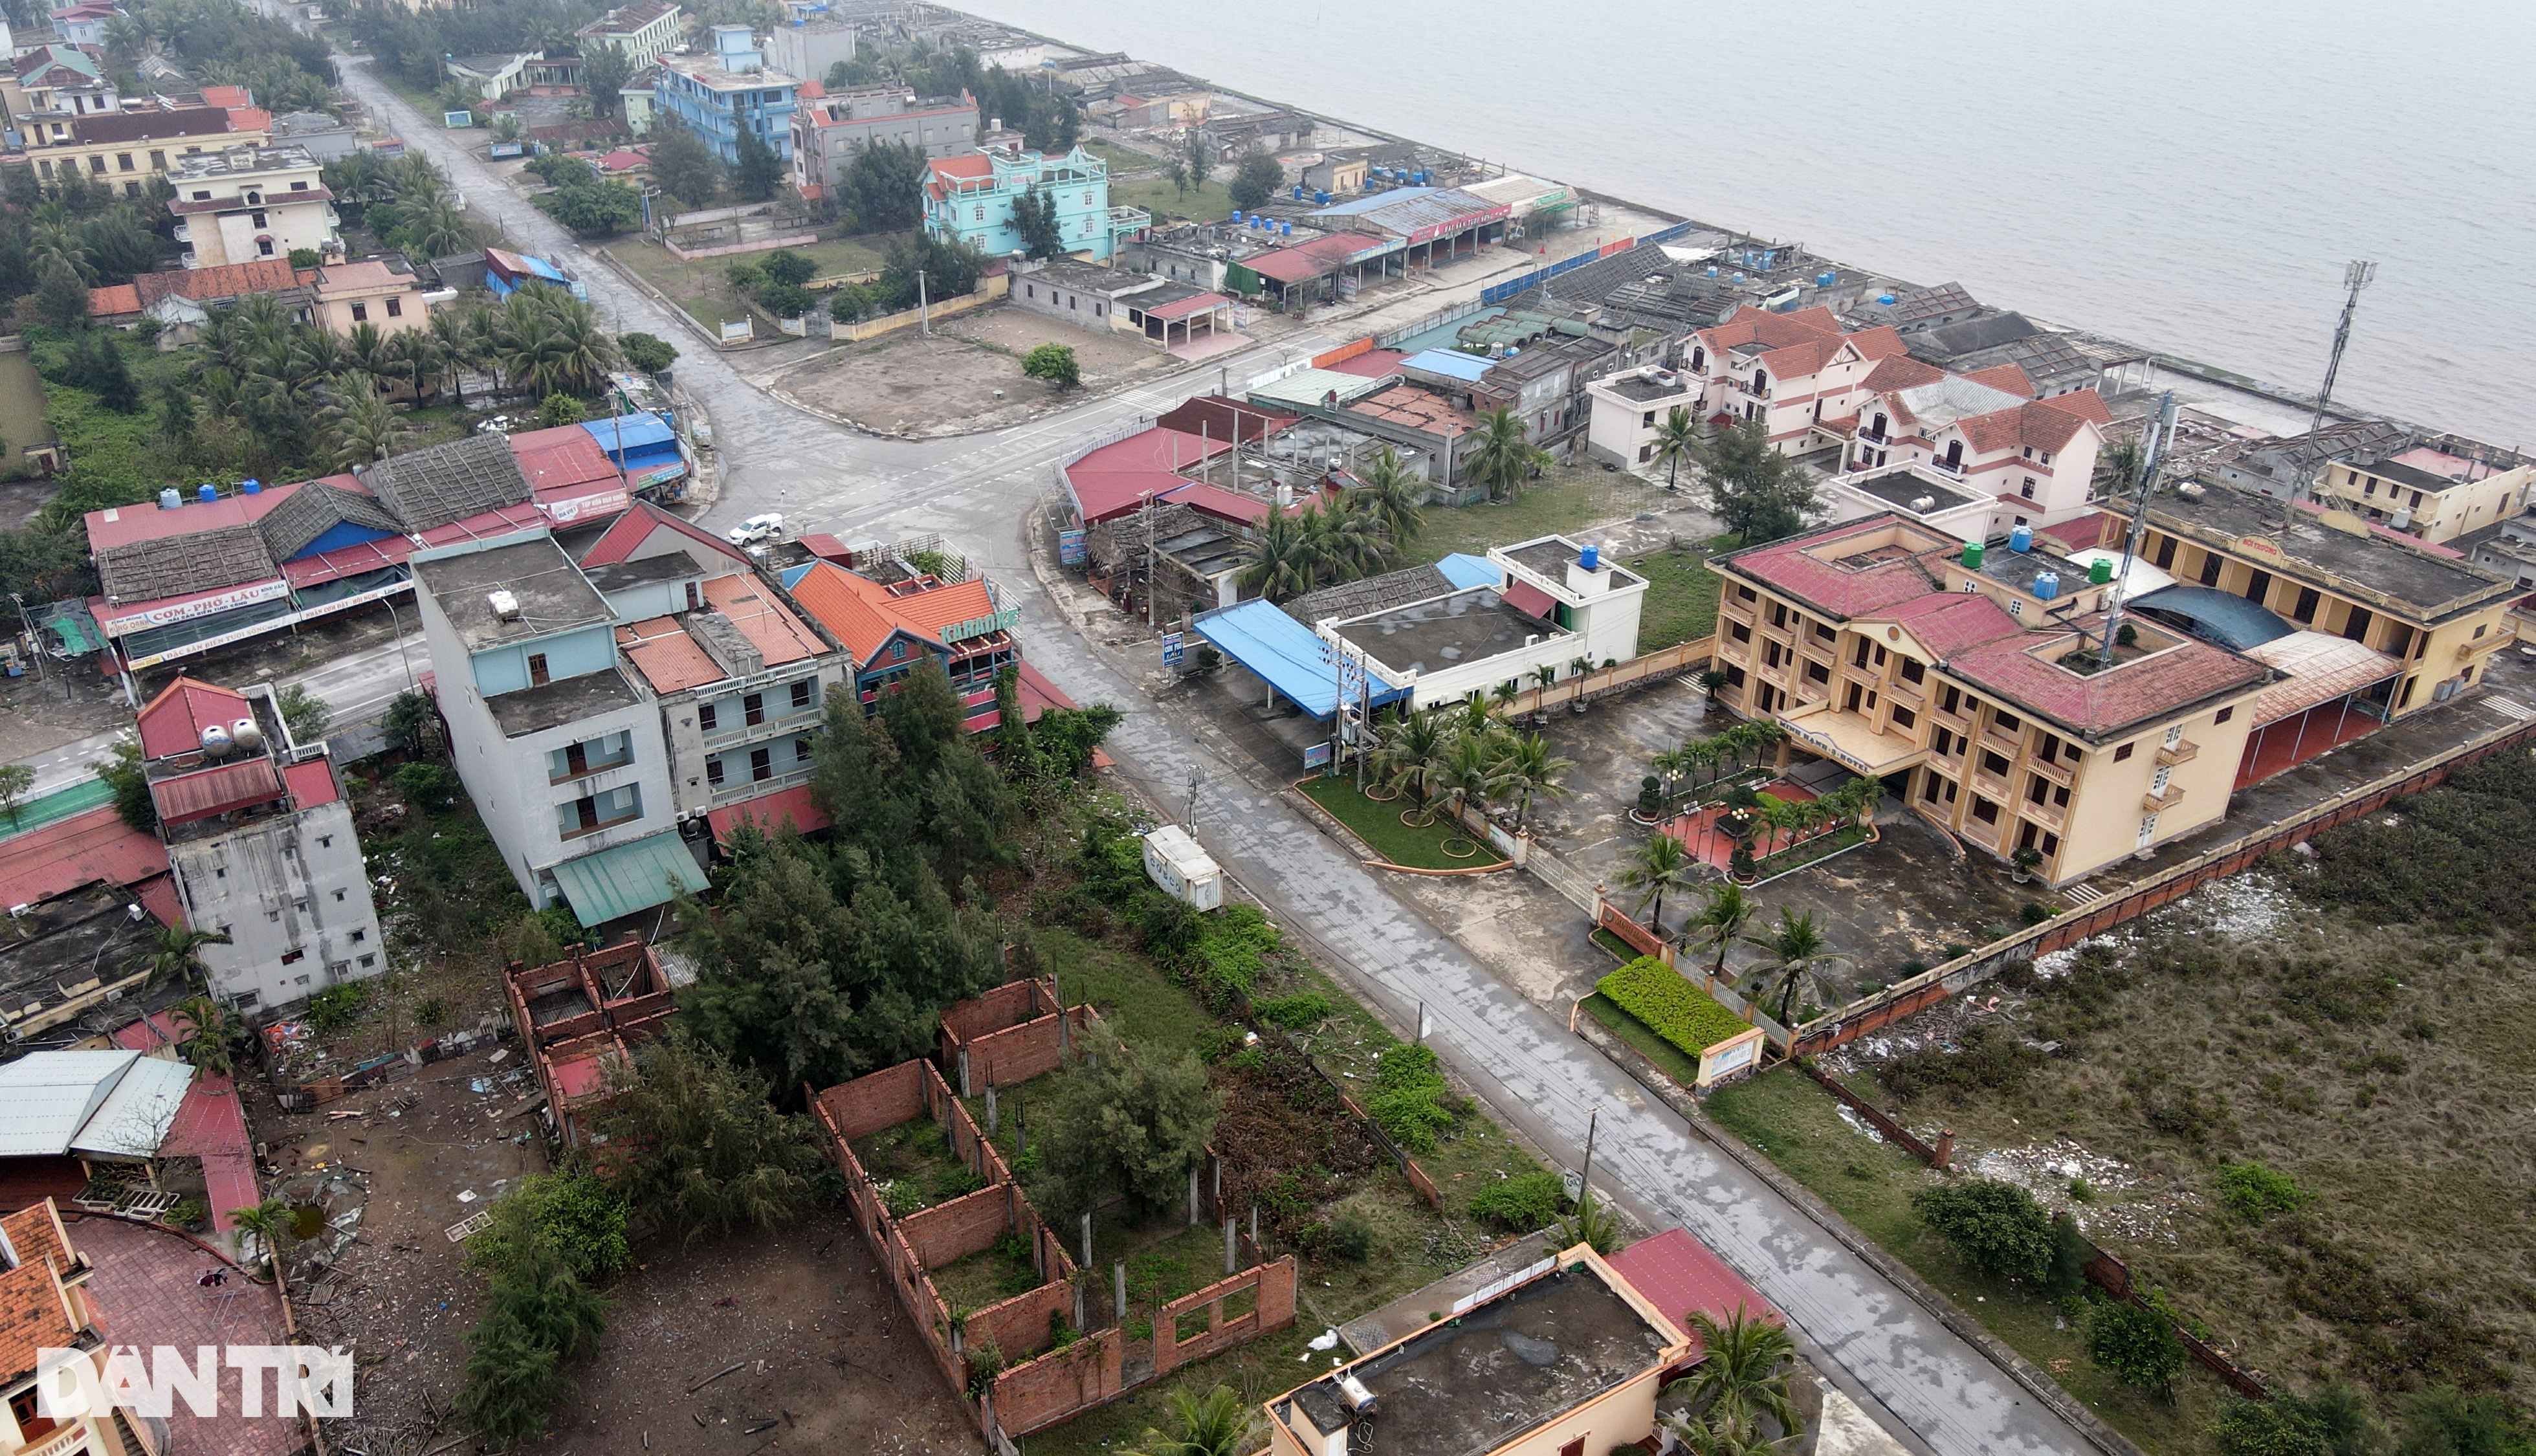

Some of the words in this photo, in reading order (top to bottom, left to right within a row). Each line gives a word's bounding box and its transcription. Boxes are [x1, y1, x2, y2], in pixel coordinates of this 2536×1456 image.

[153, 608, 185, 621] CƠM
[193, 597, 223, 612] PHỞ
[230, 590, 259, 602] LẨU
[940, 608, 1019, 643] KARAOKE
[1780, 720, 1801, 736] MINH
[1840, 753, 1869, 773] HOTEL
